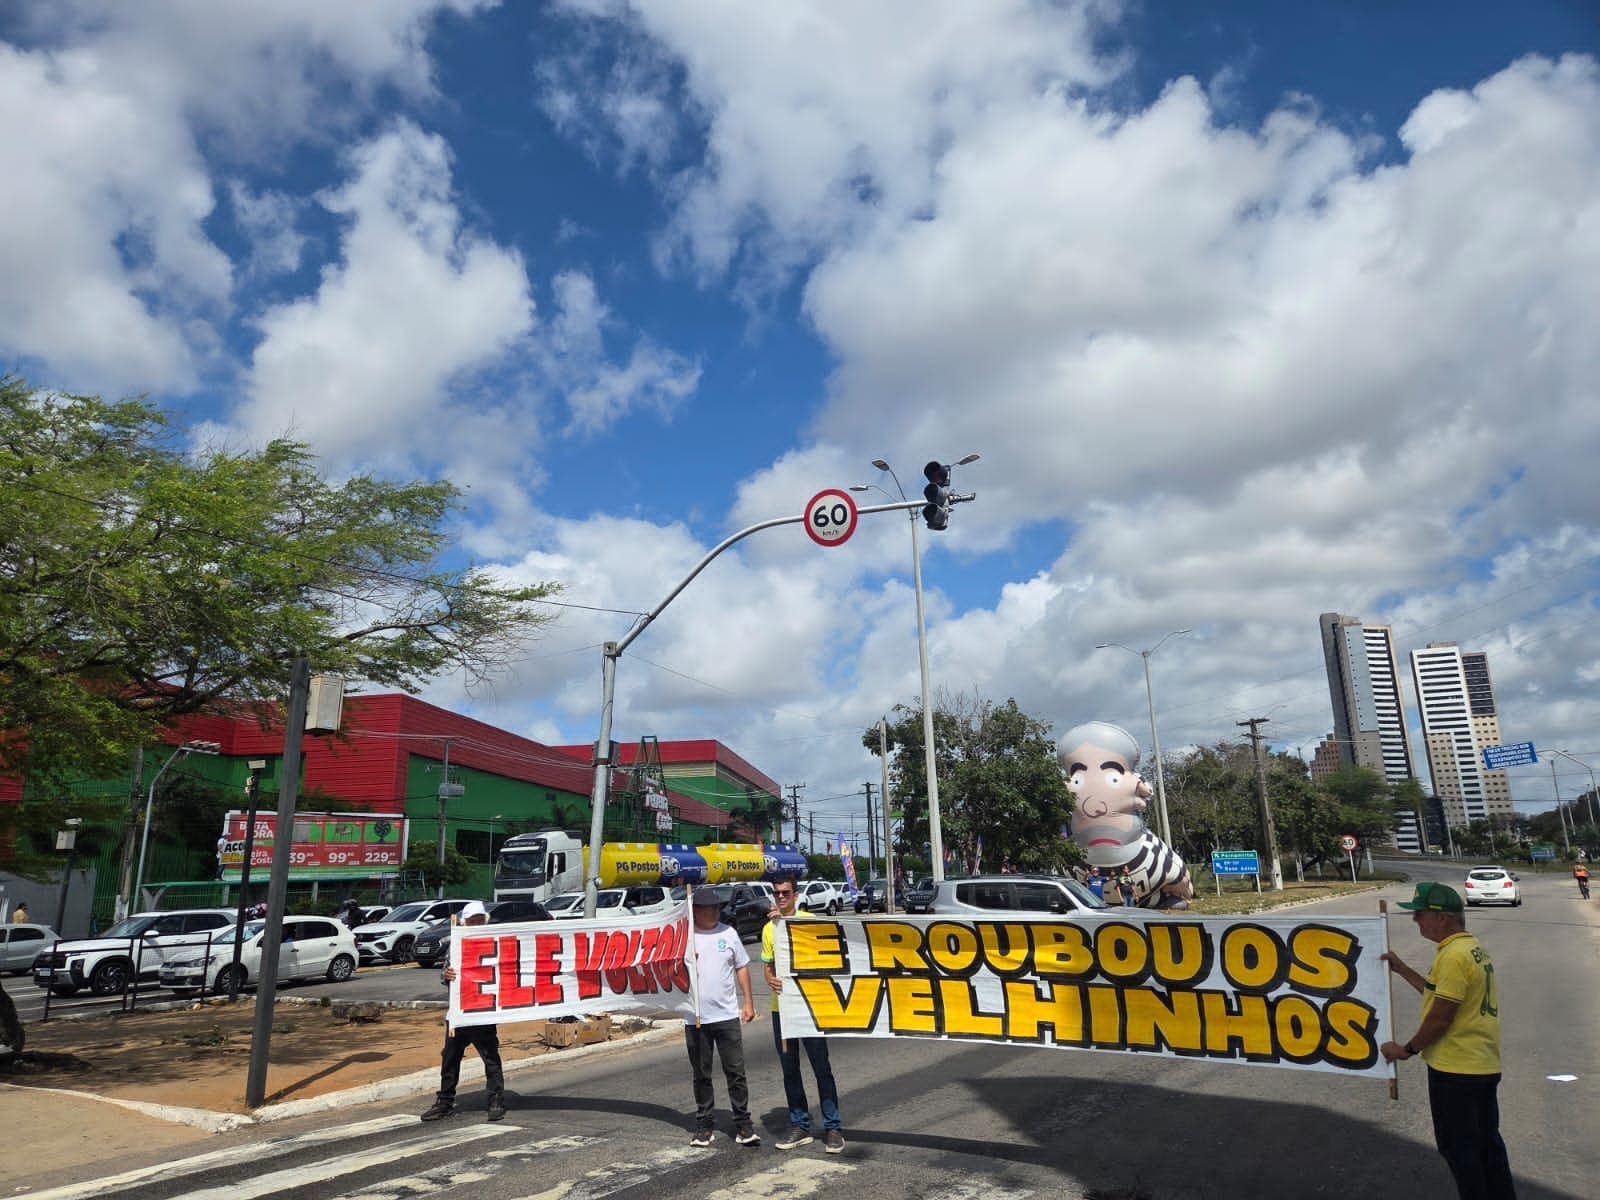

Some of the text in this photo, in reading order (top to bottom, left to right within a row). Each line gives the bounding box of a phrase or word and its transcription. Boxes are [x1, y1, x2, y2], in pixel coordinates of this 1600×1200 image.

[814, 504, 847, 527] 60
[239, 821, 269, 831] BTA
[364, 852, 389, 863] 229
[726, 861, 737, 870] PG
[738, 860, 760, 870] Postos
[616, 861, 659, 872] PG Postos
[460, 916, 690, 1013] ELE VOLTOU
[786, 920, 1363, 998] E ROUBOU OS
[792, 975, 1379, 1070] VELHINHOS
